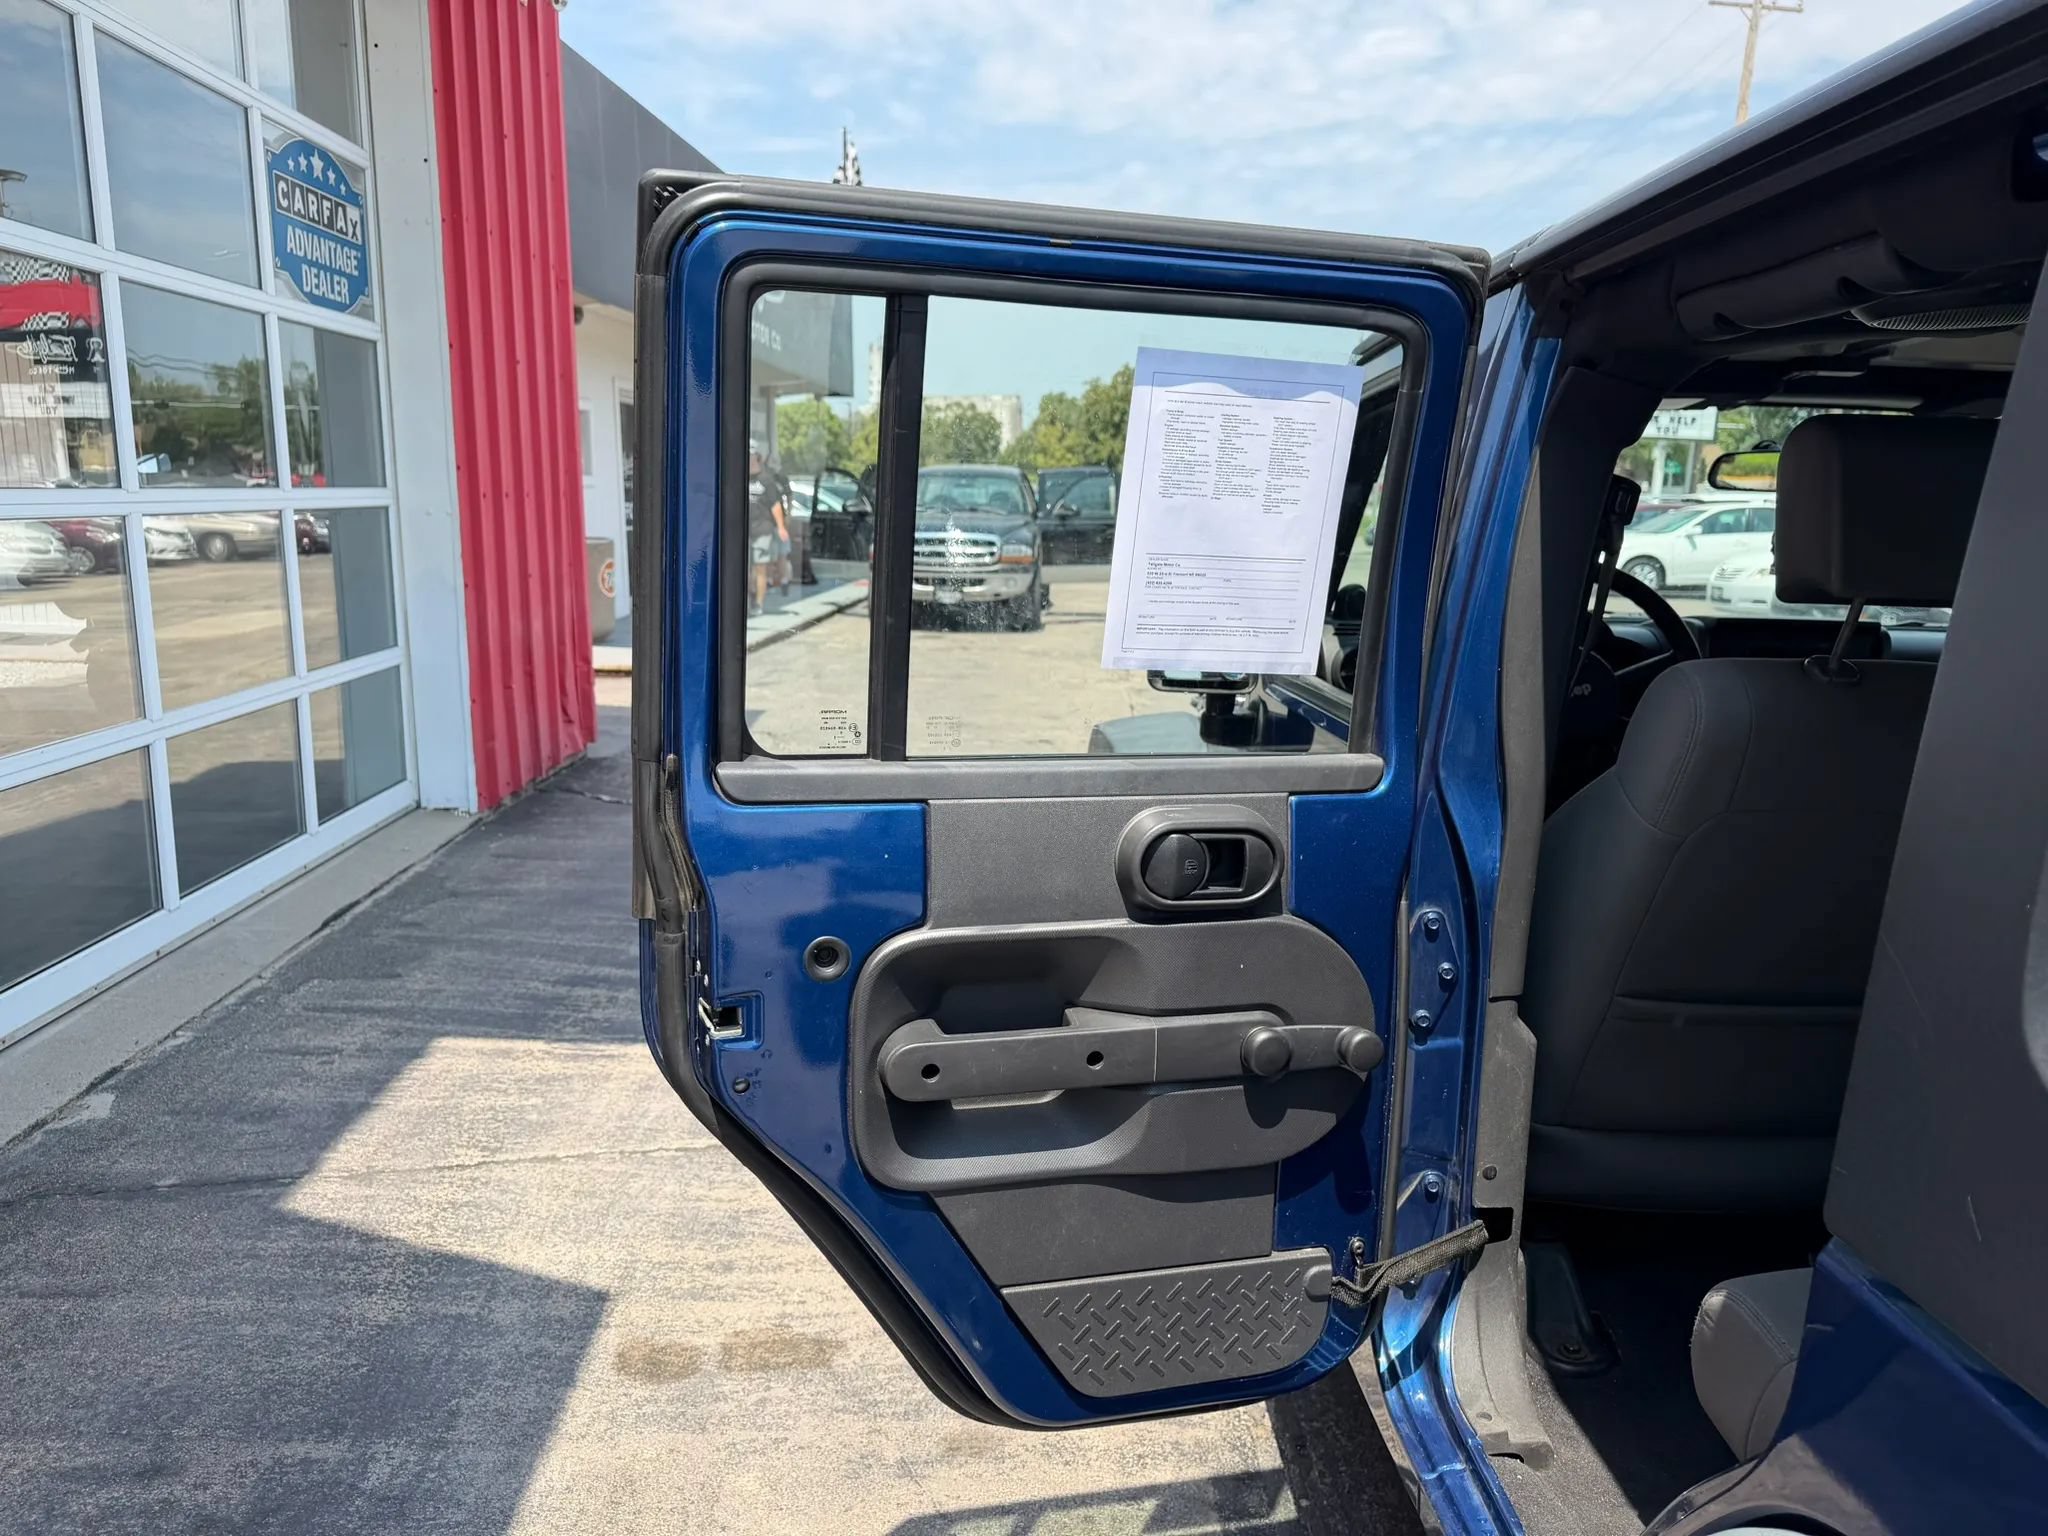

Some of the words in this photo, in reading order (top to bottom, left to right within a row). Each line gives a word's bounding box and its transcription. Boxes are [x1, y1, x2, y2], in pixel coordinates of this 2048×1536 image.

[277, 179, 359, 242] CARFAX
[286, 224, 360, 277] ADVANTAGE
[301, 263, 350, 304] DEALER
